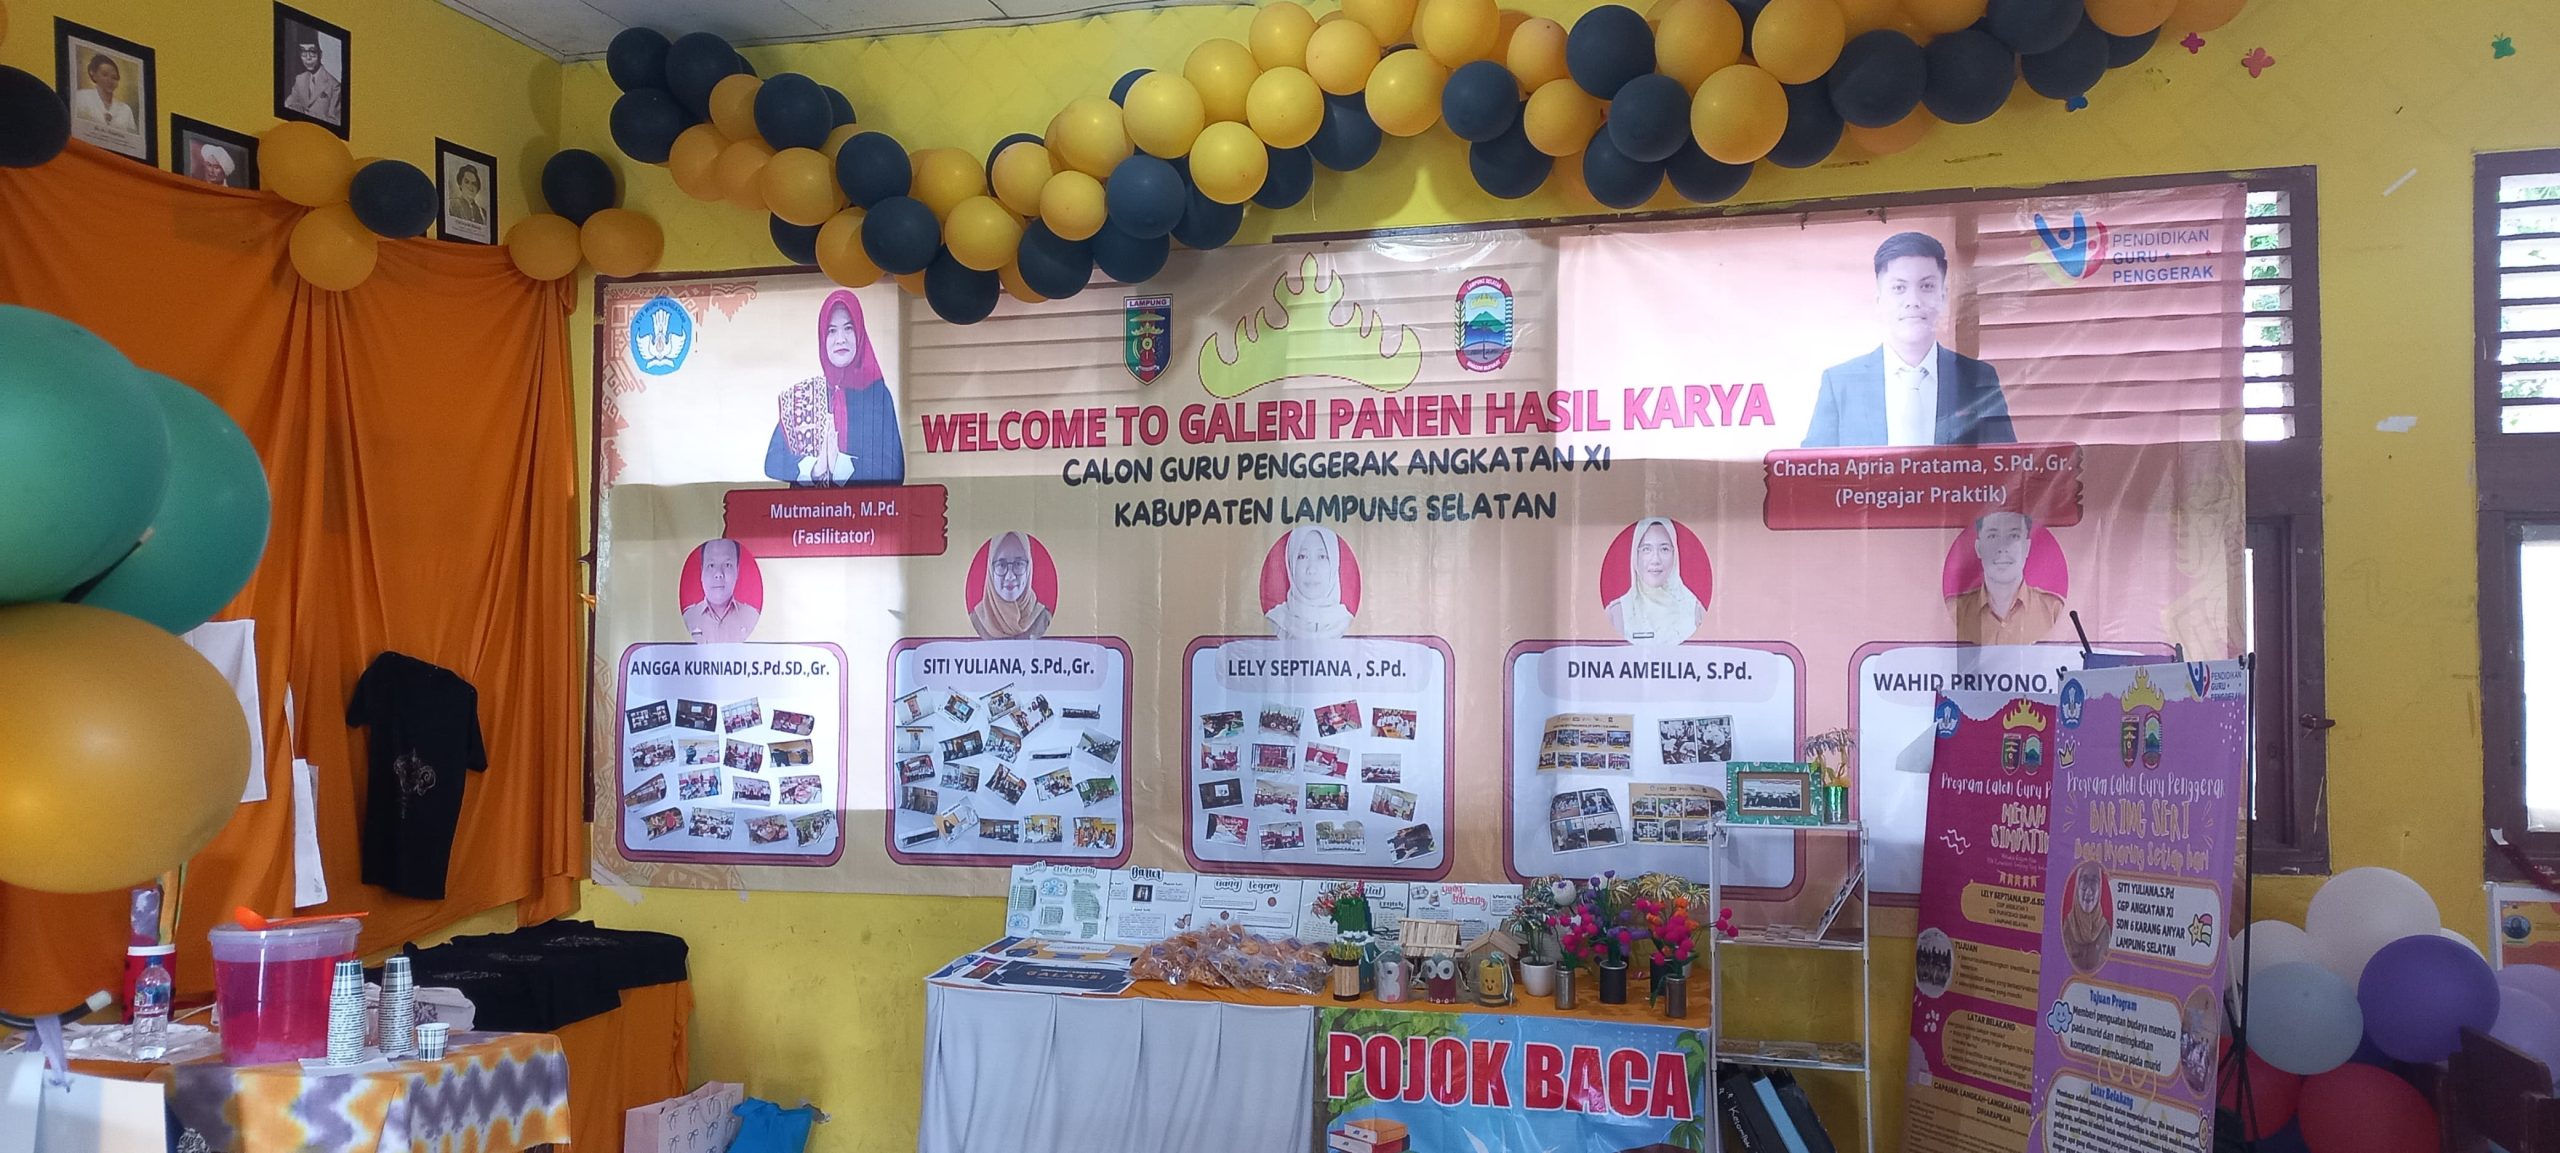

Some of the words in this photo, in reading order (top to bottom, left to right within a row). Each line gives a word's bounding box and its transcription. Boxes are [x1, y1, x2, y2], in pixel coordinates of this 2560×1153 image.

[2112, 229, 2210, 248] PENDIDIKAN
[2112, 250, 2158, 265] GURU
[2112, 265, 2214, 283] PENGGERAK
[1129, 299, 1168, 307] LAMPUNG
[920, 406, 1107, 454] WELCOME
[1114, 403, 1169, 447] TO
[1178, 398, 1317, 446] GALERI
[1329, 393, 1473, 440] PANEN
[1484, 388, 1611, 435] HASIL
[1622, 382, 1776, 431] KARYA
[1061, 456, 1154, 486] CALON
[1160, 454, 1231, 484] GURU
[1237, 449, 1399, 482] PENGGERAK
[1407, 445, 1575, 476] ANGKATAN
[1582, 444, 1611, 473] XI
[1772, 458, 1840, 478] Chacha
[1844, 457, 1895, 480] Apria
[1900, 455, 1988, 476] Pratama,
[1835, 487, 1923, 509] (Pengajar
[1929, 484, 2007, 504] Praktik)
[769, 503, 856, 520] Mutmainah,
[860, 500, 899, 517] M.Pd.
[1114, 497, 1273, 528] KABUPATEN
[1279, 494, 1418, 525] LAMPUNG
[1426, 491, 1557, 522] SELATAN
[792, 527, 875, 548] (Fasilitator)
[630, 660, 681, 676] ANGGA
[923, 658, 950, 675] SITI
[954, 657, 1027, 677] YULIANA,
[1030, 656, 1095, 677] S.Pd.,Gr.
[1228, 659, 1267, 677] LELY
[1270, 659, 1352, 677] SEPTIANA
[1365, 659, 1407, 678] S.Pd.
[1567, 660, 1615, 679] DINA
[1618, 661, 1701, 682] AMEILIA,
[1706, 661, 1752, 680] S.Pd.
[1873, 672, 1944, 692] WAHID
[1951, 673, 2053, 694] PRIYONO,
[1941, 771, 1984, 796] Program
[1986, 778, 2014, 796] Calon
[2016, 778, 2042, 800] Guru
[2066, 771, 2108, 798] Program
[2110, 773, 2137, 796] Calon
[2139, 772, 2165, 798] Guru
[2168, 771, 2225, 803] Penggerak
[2001, 801, 2047, 829] MERAH
[2151, 798, 2190, 843] SERI
[2117, 882, 2130, 894] SITI
[2117, 900, 2129, 912] CGP
[2131, 902, 2165, 917] ANGKATAN
[2166, 906, 2174, 918] XI
[2116, 918, 2129, 931] SDN
[2135, 922, 2161, 936] KARANG
[2162, 924, 2186, 940] ANYAR
[1954, 941, 1978, 953] TUJUAN
[2116, 936, 2145, 951] LAMPUNG
[2146, 941, 2176, 957] SELATAN
[2089, 989, 2111, 1006] Tujuan
[2111, 993, 2137, 1012] Program
[1967, 1013, 1986, 1025] LATAR
[1985, 1018, 2016, 1032] BELAKANG
[2072, 1005, 2097, 1018] Memberi
[2096, 1012, 2126, 1027] penguatan
[2127, 1016, 2148, 1034] budaya
[2148, 1024, 2177, 1040] membaca
[2071, 1023, 2086, 1034] pada
[2086, 1026, 2102, 1039] murid
[2102, 1030, 2114, 1041] dan
[2114, 1033, 2154, 1052] meningkatkan
[2070, 1038, 2101, 1056] kompetensi
[2101, 1047, 2129, 1063] membaca
[2128, 1055, 2143, 1067] pada
[2143, 1059, 2161, 1072] murid
[1326, 1031, 1513, 1110] POJOK
[1524, 1041, 1695, 1122] BACA
